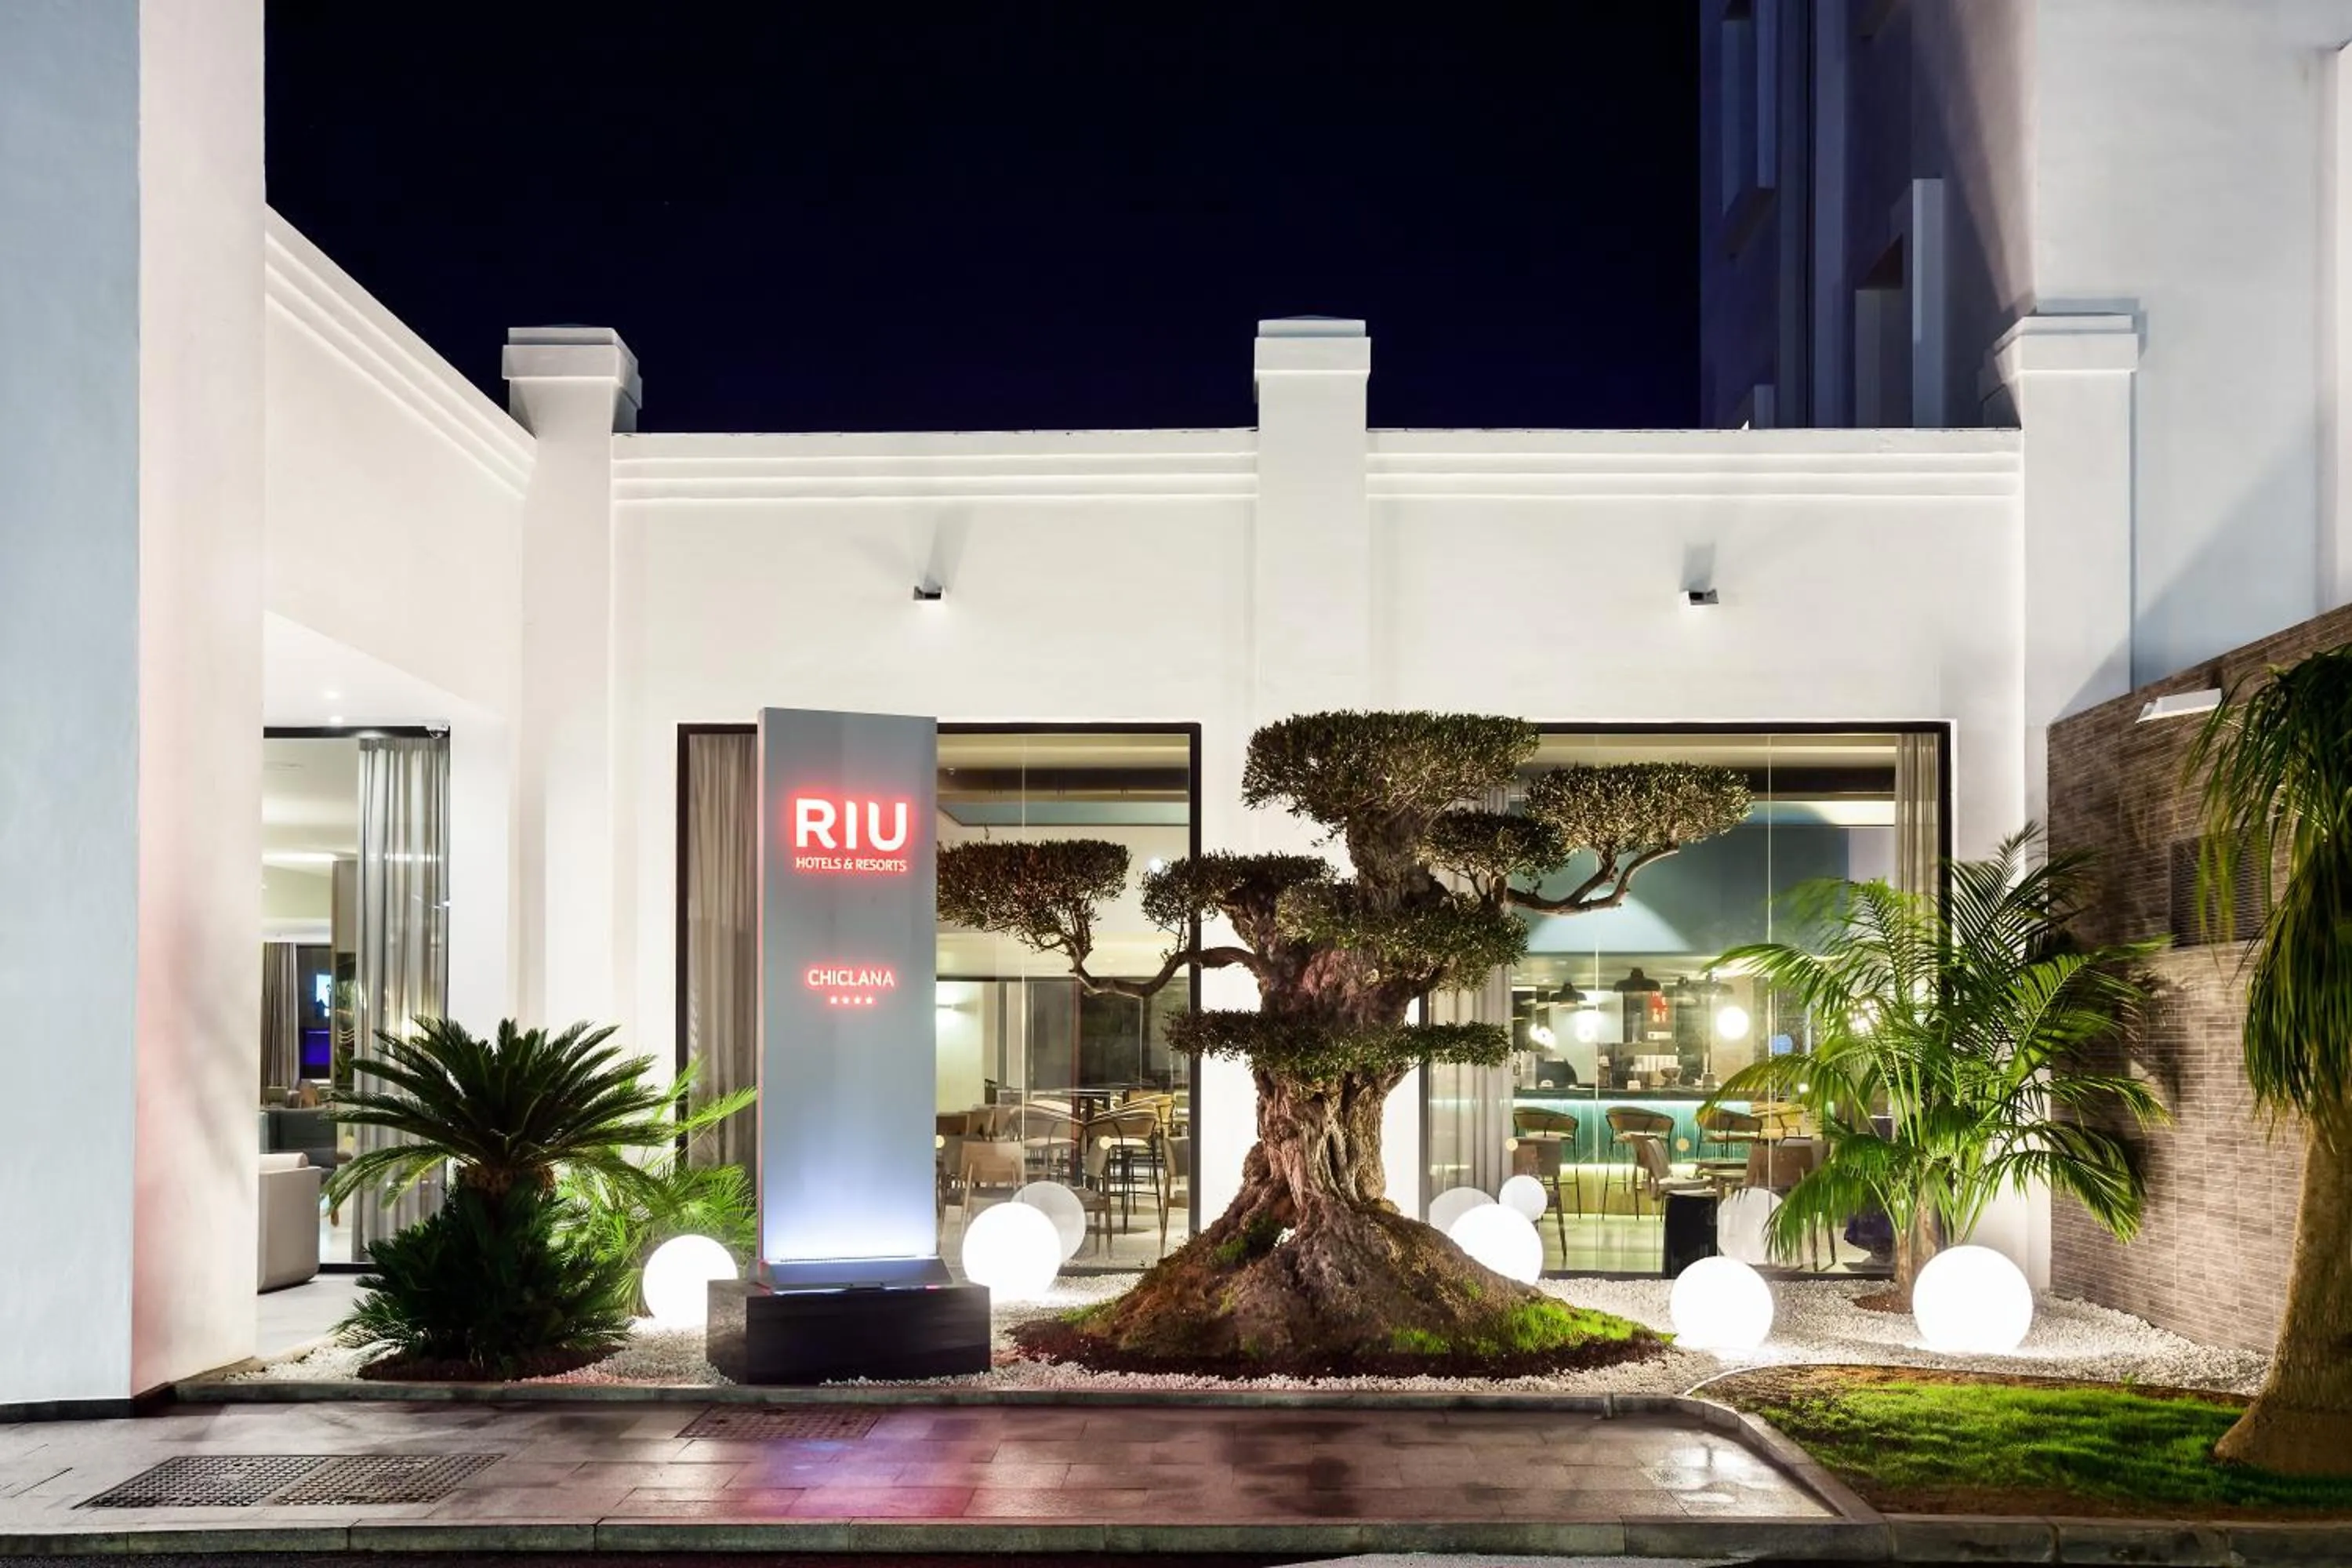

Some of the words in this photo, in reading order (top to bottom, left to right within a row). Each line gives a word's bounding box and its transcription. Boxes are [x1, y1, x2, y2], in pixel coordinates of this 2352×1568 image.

[795, 797, 908, 851] RIU
[796, 856, 842, 869] HOTELS
[843, 857, 854, 870] &
[855, 858, 907, 872] RESORTS
[808, 969, 895, 987] CHICLANA
